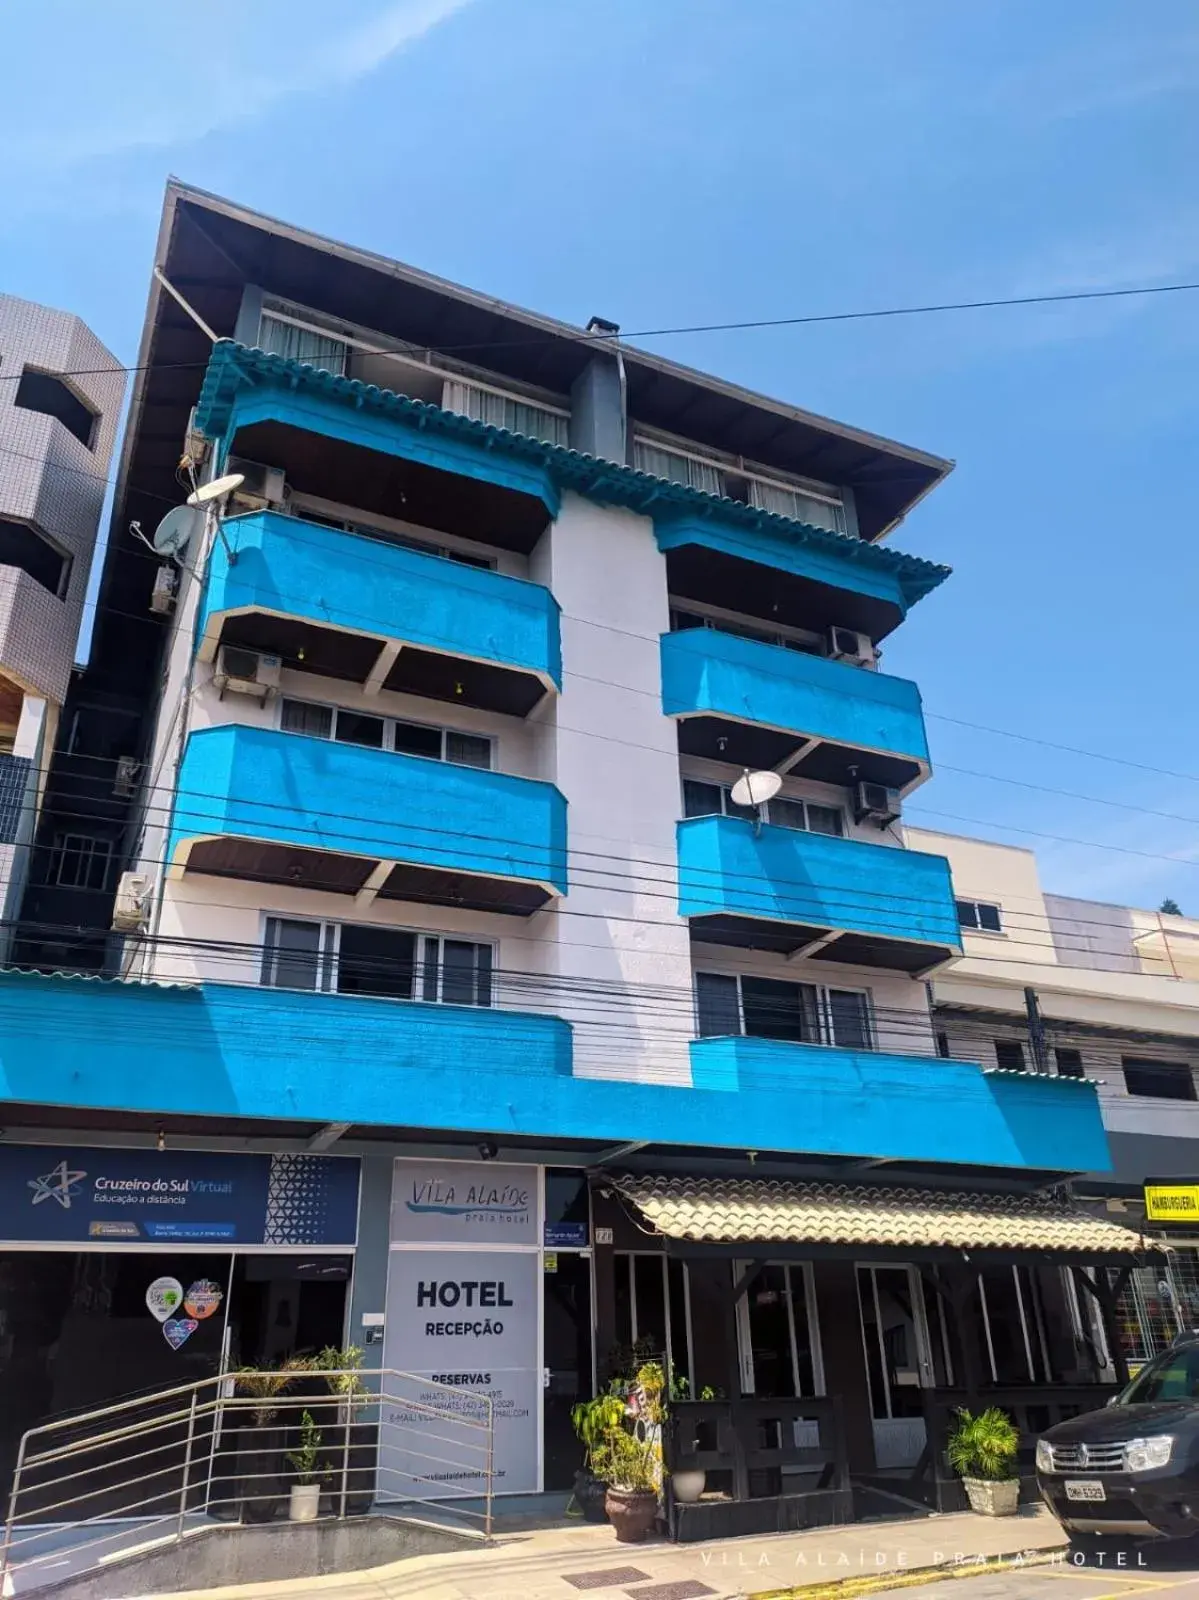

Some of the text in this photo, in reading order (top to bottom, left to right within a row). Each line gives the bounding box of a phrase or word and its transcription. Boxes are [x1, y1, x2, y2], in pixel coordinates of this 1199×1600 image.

[95, 1177, 232, 1193] Cruzeiro do Sul Virtual
[413, 1179, 456, 1204] VILA
[93, 1193, 138, 1205] Educação
[146, 1194, 186, 1205] distância
[1152, 1195, 1196, 1210] HAMBURGUERIA
[465, 1214, 529, 1224] praia hotel
[417, 1281, 513, 1307] HOTEL
[425, 1318, 504, 1338] RECEPÇÃO
[432, 1373, 492, 1385] RESERVAS
